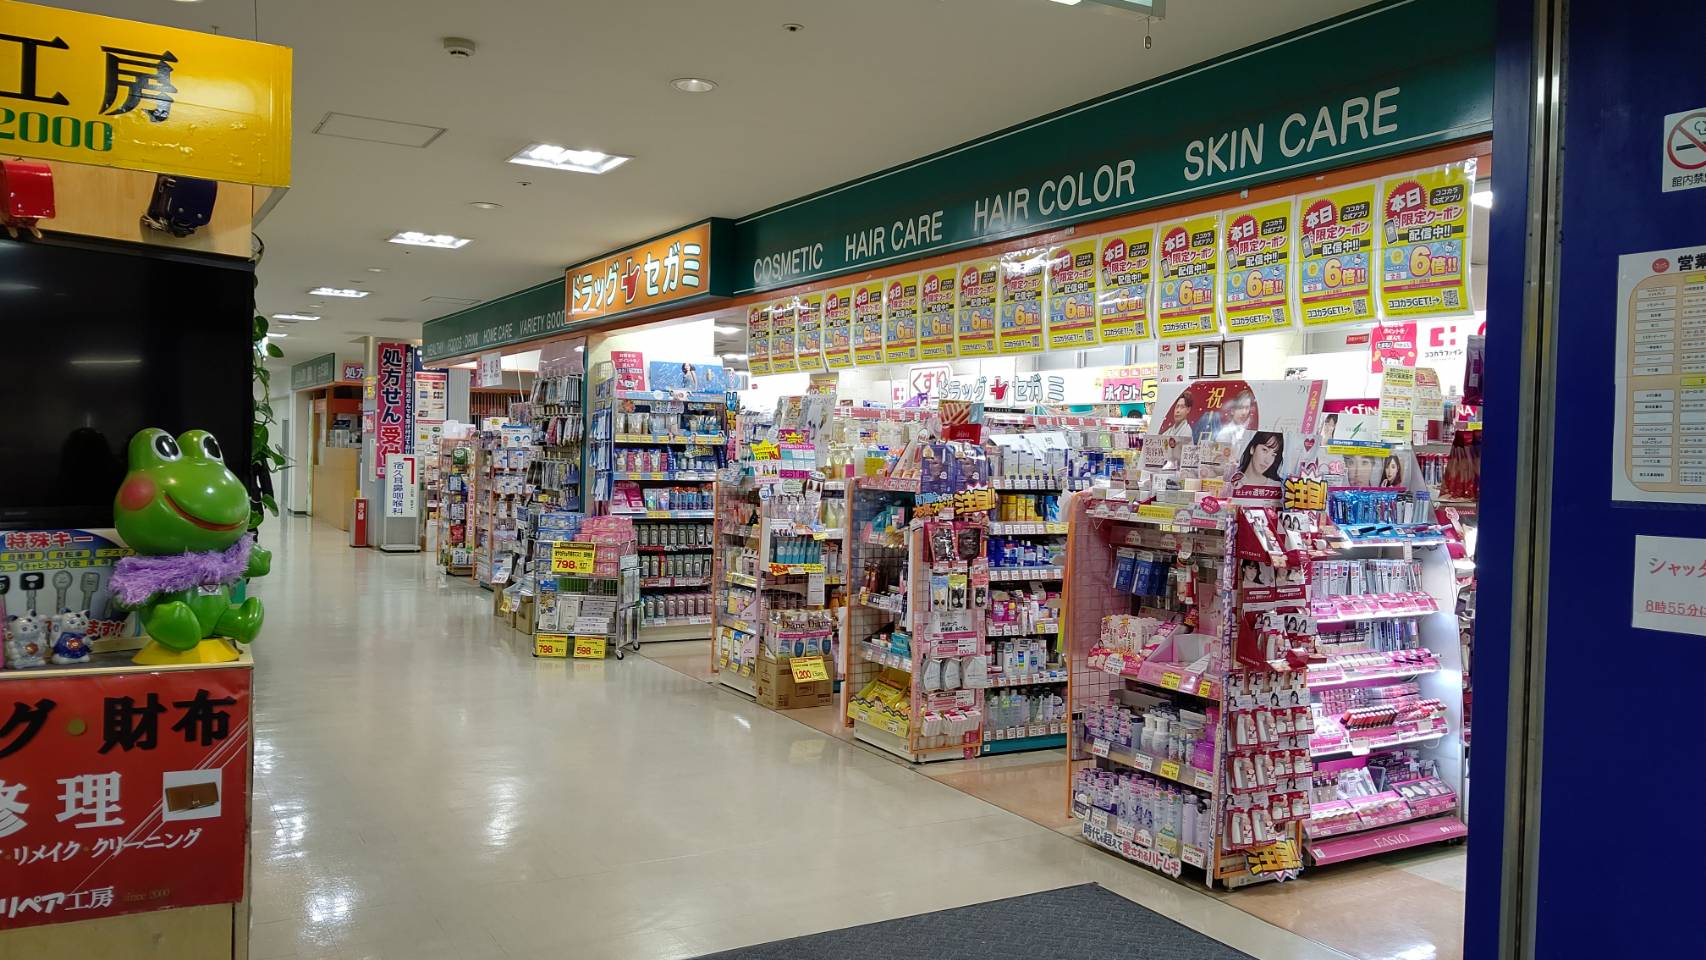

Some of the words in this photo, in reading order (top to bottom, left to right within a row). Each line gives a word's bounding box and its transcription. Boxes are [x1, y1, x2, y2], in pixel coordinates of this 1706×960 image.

[0, 33, 179, 123] 工房
[0, 108, 113, 152] 2000
[1184, 123, 1264, 181] SKIN
[1279, 86, 1400, 157] CARE
[1672, 173, 1706, 187] 館内禁
[973, 188, 1029, 231] HAIR
[1039, 159, 1136, 215] COLOR
[1390, 188, 1421, 212] 本日
[1305, 206, 1332, 227] 本日
[1401, 206, 1464, 227] 限定クーポン
[845, 226, 885, 263] HAIR
[891, 210, 944, 251] CARE
[1231, 220, 1254, 241] 本日
[1314, 221, 1370, 242] 限定クーポン
[1408, 225, 1451, 242] 配信中!!
[1104, 242, 1124, 262] 本日
[1165, 232, 1186, 252] 本日
[1239, 236, 1286, 255] 限定クーポン
[1321, 240, 1360, 255] 配信中!!
[753, 242, 823, 282] COSMETIC
[1171, 247, 1215, 265] 限定クーポン
[1245, 251, 1279, 267] 配信中!!
[1409, 245, 1458, 277] 6倍!!
[571, 259, 619, 313] ドラッグ
[644, 241, 702, 295] セガミ
[1323, 258, 1366, 288] 6倍!!
[519, 313, 546, 335] VARIETY
[937, 374, 986, 401] ドラッグ
[1012, 374, 1065, 401] セガミ
[1105, 383, 1141, 401] ポイント
[1206, 386, 1226, 409] 祝
[5, 531, 93, 550] 特殊キー
[556, 560, 575, 569] 798
[782, 619, 805, 629] Diane
